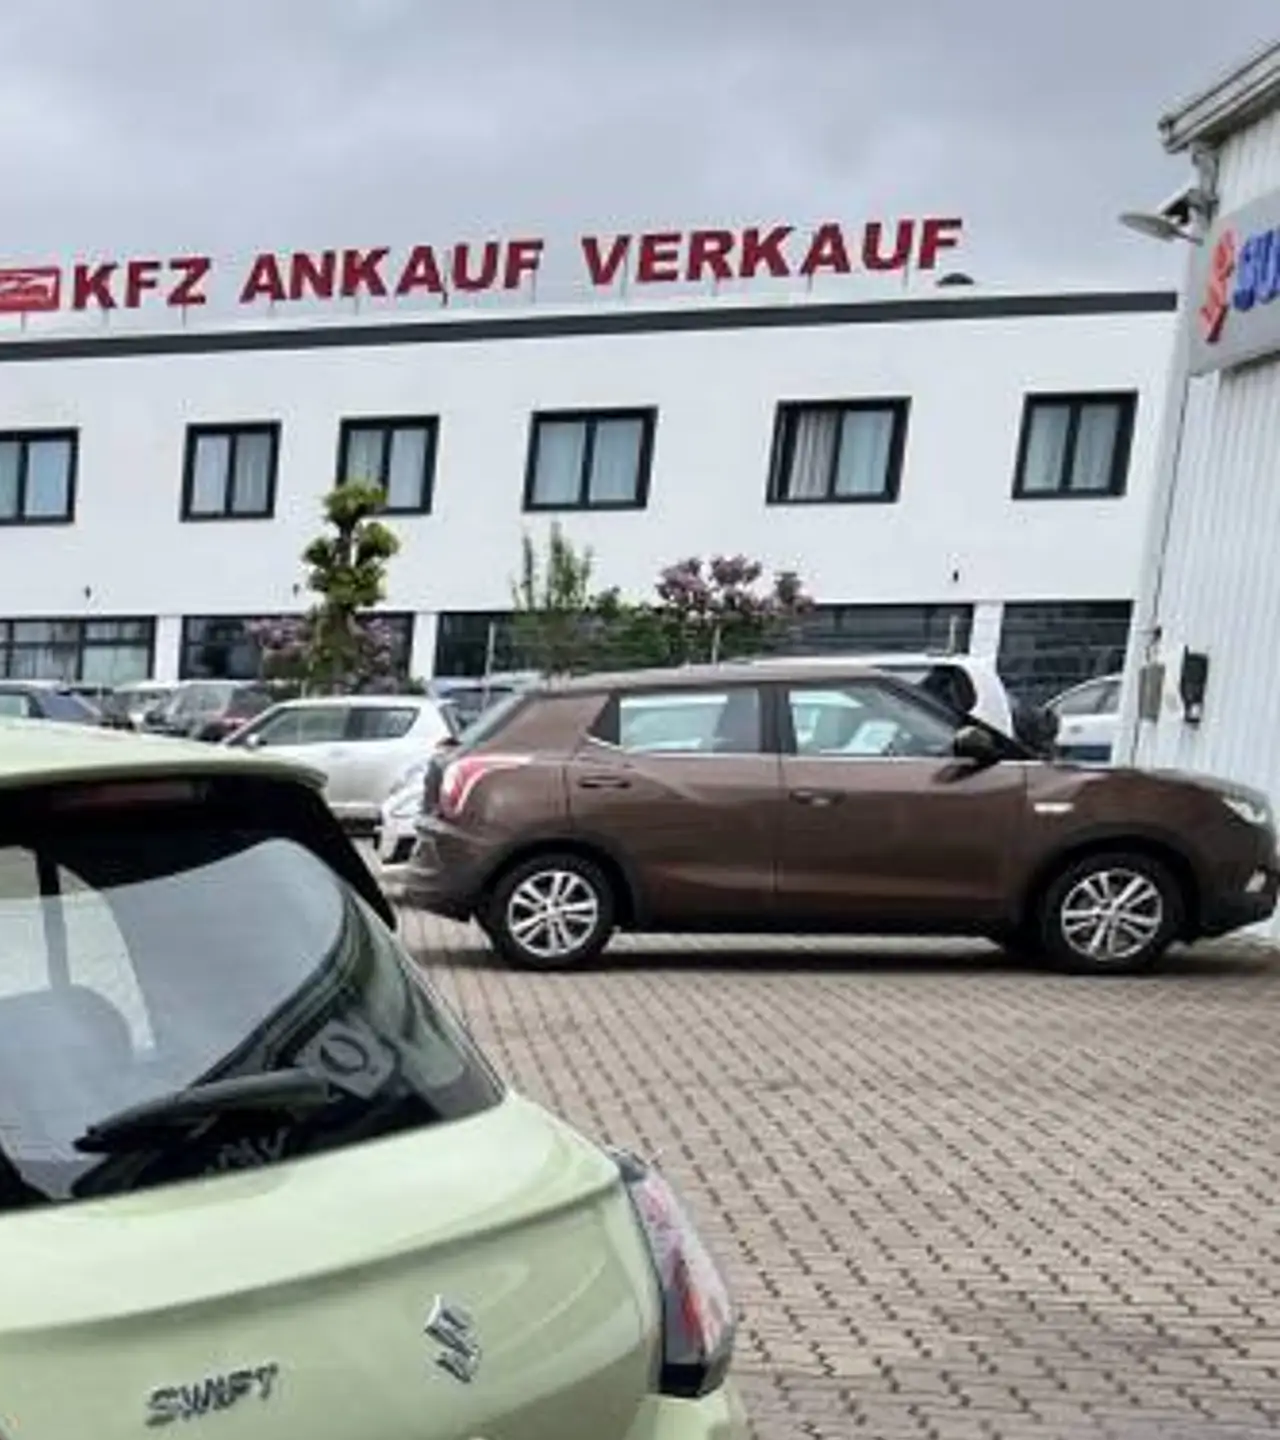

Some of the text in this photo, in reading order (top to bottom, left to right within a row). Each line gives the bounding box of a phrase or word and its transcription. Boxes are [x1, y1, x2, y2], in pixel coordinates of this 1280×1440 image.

[71, 217, 963, 310] KFZ ANKAUF VERKAUF
[144, 1362, 278, 1428] SWIFT
